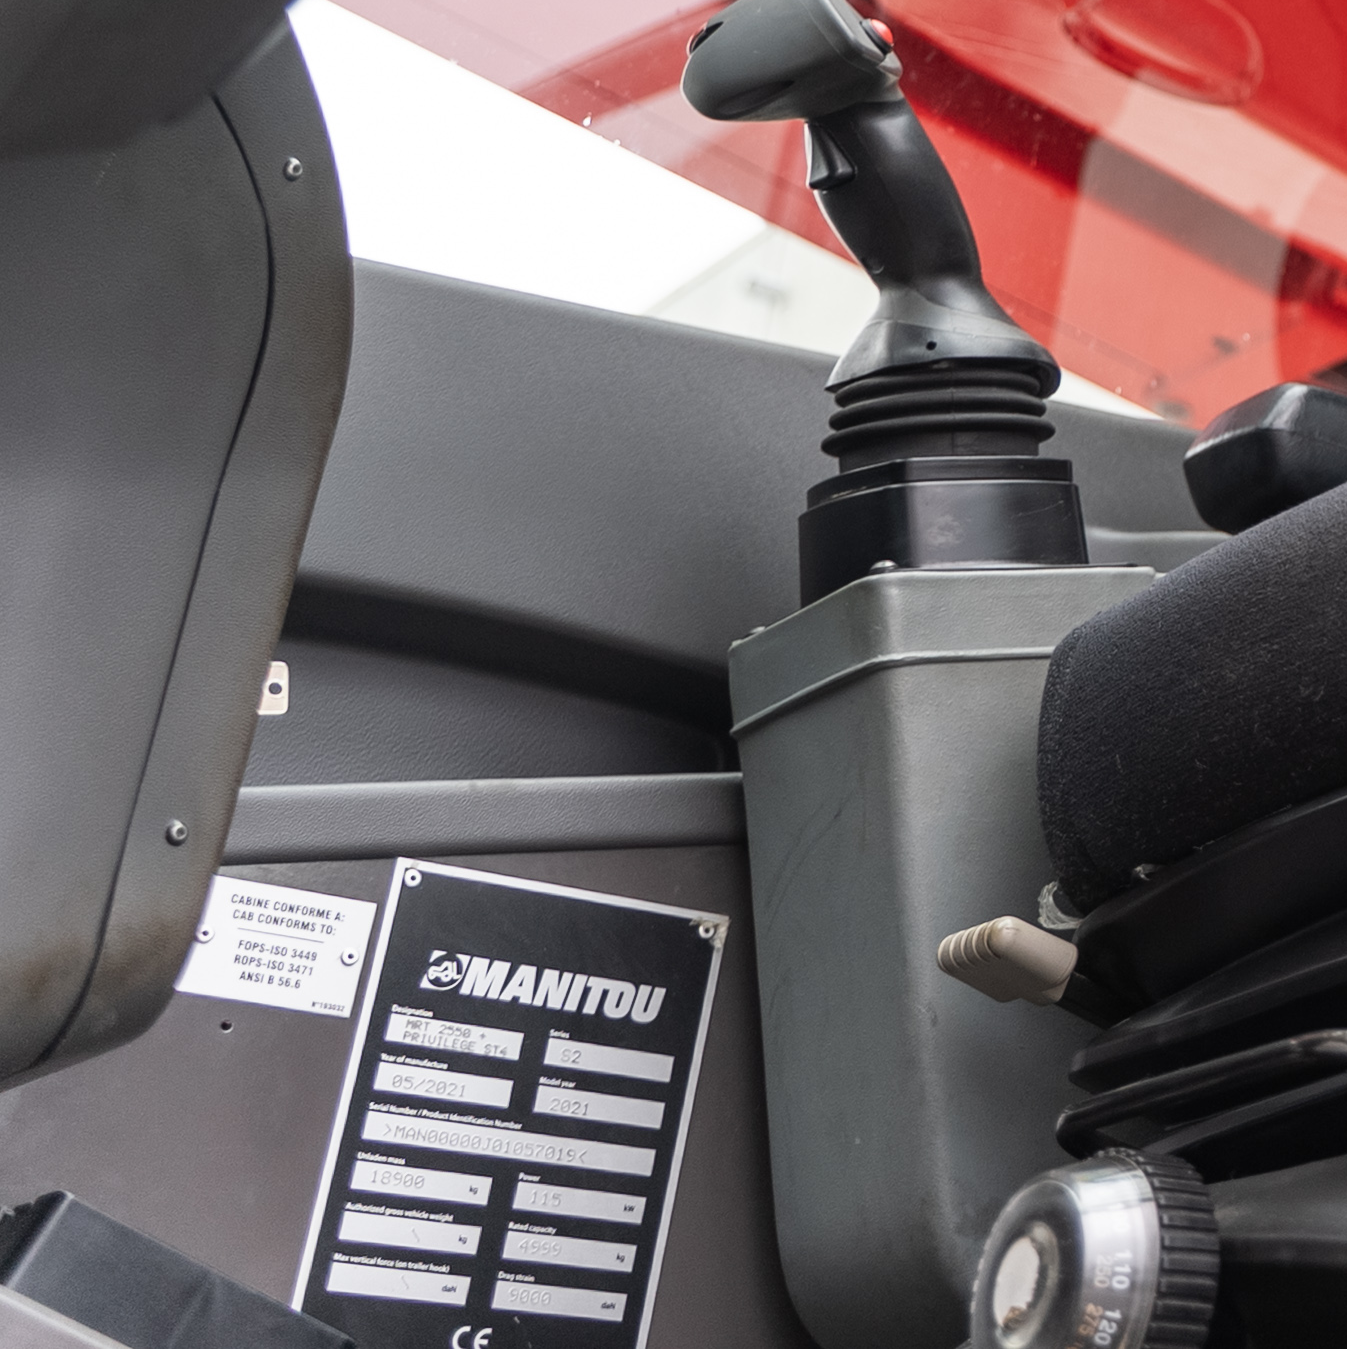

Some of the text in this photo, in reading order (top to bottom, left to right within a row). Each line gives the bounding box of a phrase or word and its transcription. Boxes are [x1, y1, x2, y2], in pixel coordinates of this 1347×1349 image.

[231, 894, 346, 922] CABINE CONFORME A:
[233, 909, 336, 936] CAB CONFORMS TO:
[238, 939, 317, 961] FOPS-ISO 3449
[234, 954, 314, 976] ROPS-ISO 3471
[239, 971, 301, 989] ANSI B 56.6
[459, 956, 667, 1023] MANITOU
[392, 1075, 466, 1098] 05/2021
[539, 1076, 576, 1088] Model year
[369, 1102, 389, 1111] Serial
[390, 1104, 418, 1116] Number
[422, 1109, 449, 1119] Product
[495, 1119, 522, 1130] Number
[550, 1098, 589, 1116] 2021
[357, 1151, 405, 1165] Unladen mass
[370, 1170, 425, 1189] 18900
[519, 1172, 541, 1182] Power
[530, 1189, 562, 1207] 115
[345, 1202, 454, 1224] Authorized gross vehicle weight
[508, 1221, 557, 1236] Rated capacity
[517, 1237, 625, 1263] 4999 kg
[333, 1252, 350, 1262] Max
[350, 1255, 377, 1265] vertical
[376, 1257, 395, 1267] force
[407, 1261, 429, 1271] trailer
[498, 1271, 535, 1282] Drag strain
[508, 1286, 551, 1305] 9000
[452, 1325, 493, 1349] CE
[1094, 1309, 1122, 1346] 120
